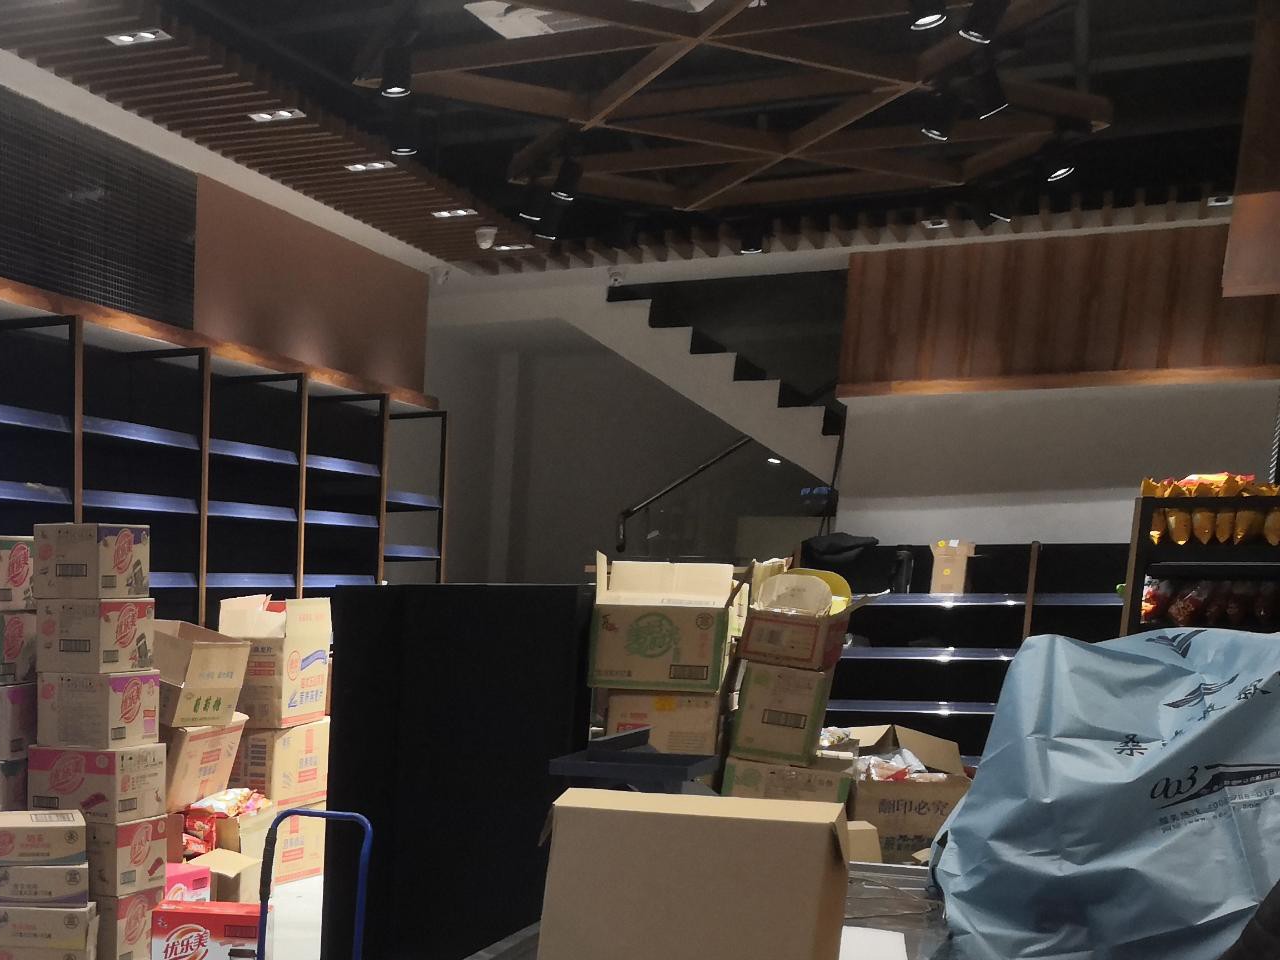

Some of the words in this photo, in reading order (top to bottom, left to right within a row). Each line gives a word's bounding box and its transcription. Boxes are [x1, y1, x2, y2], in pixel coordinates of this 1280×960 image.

[878, 798, 949, 816] 翻印必究
[163, 930, 210, 960] 优乐美
